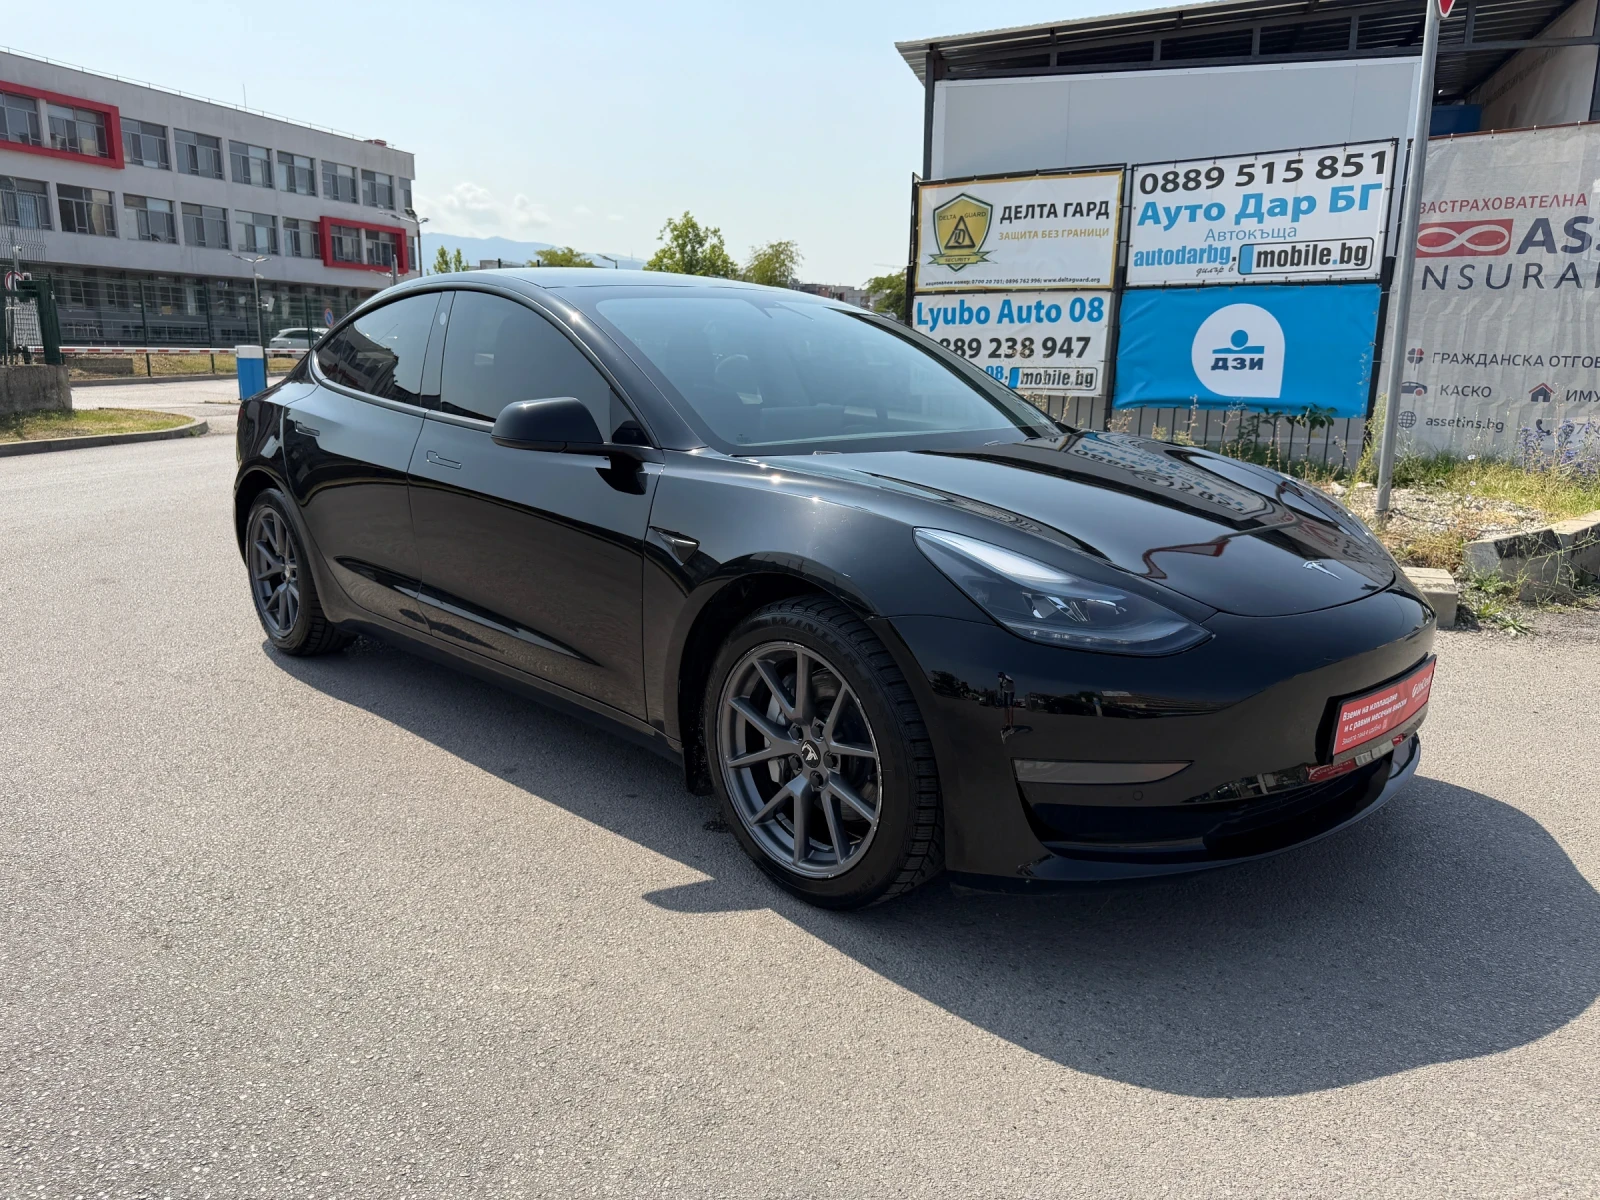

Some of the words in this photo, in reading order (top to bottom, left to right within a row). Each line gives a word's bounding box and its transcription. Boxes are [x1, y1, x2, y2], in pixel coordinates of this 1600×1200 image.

[1139, 166, 1225, 195] 0889
[1235, 159, 1303, 187] 515
[1315, 150, 1386, 180] 851
[964, 211, 987, 219] GUARD
[1000, 203, 1058, 224] ДЕЛТА
[1063, 200, 1110, 220] ГАРД
[1137, 201, 1226, 232] Ауто
[1234, 193, 1317, 226] Дар
[1328, 183, 1383, 213] БГ
[999, 230, 1039, 241] ЗАЩИТА
[1041, 229, 1059, 239] БЕЗ
[1061, 227, 1110, 239] ГРАНИЦИ
[1204, 227, 1297, 242] Автокъща
[1516, 215, 1600, 255] AS
[1255, 242, 1368, 269] mobile.bg
[1043, 277, 1101, 285] www.deltaguard.org
[1421, 261, 1600, 291] NSURA
[916, 299, 991, 332] Lyubo
[997, 299, 1062, 324] Auto
[1069, 297, 1104, 323] 08
[988, 337, 1035, 359] 238
[1041, 336, 1091, 359] 947
[1210, 357, 1264, 371] ДЗИ
[1432, 352, 1544, 368] ГРАЖДАНСКА
[1020, 369, 1094, 388] mobile.bg
[1439, 384, 1492, 398] КАСКО
[1425, 416, 1504, 433] assetins.bg
